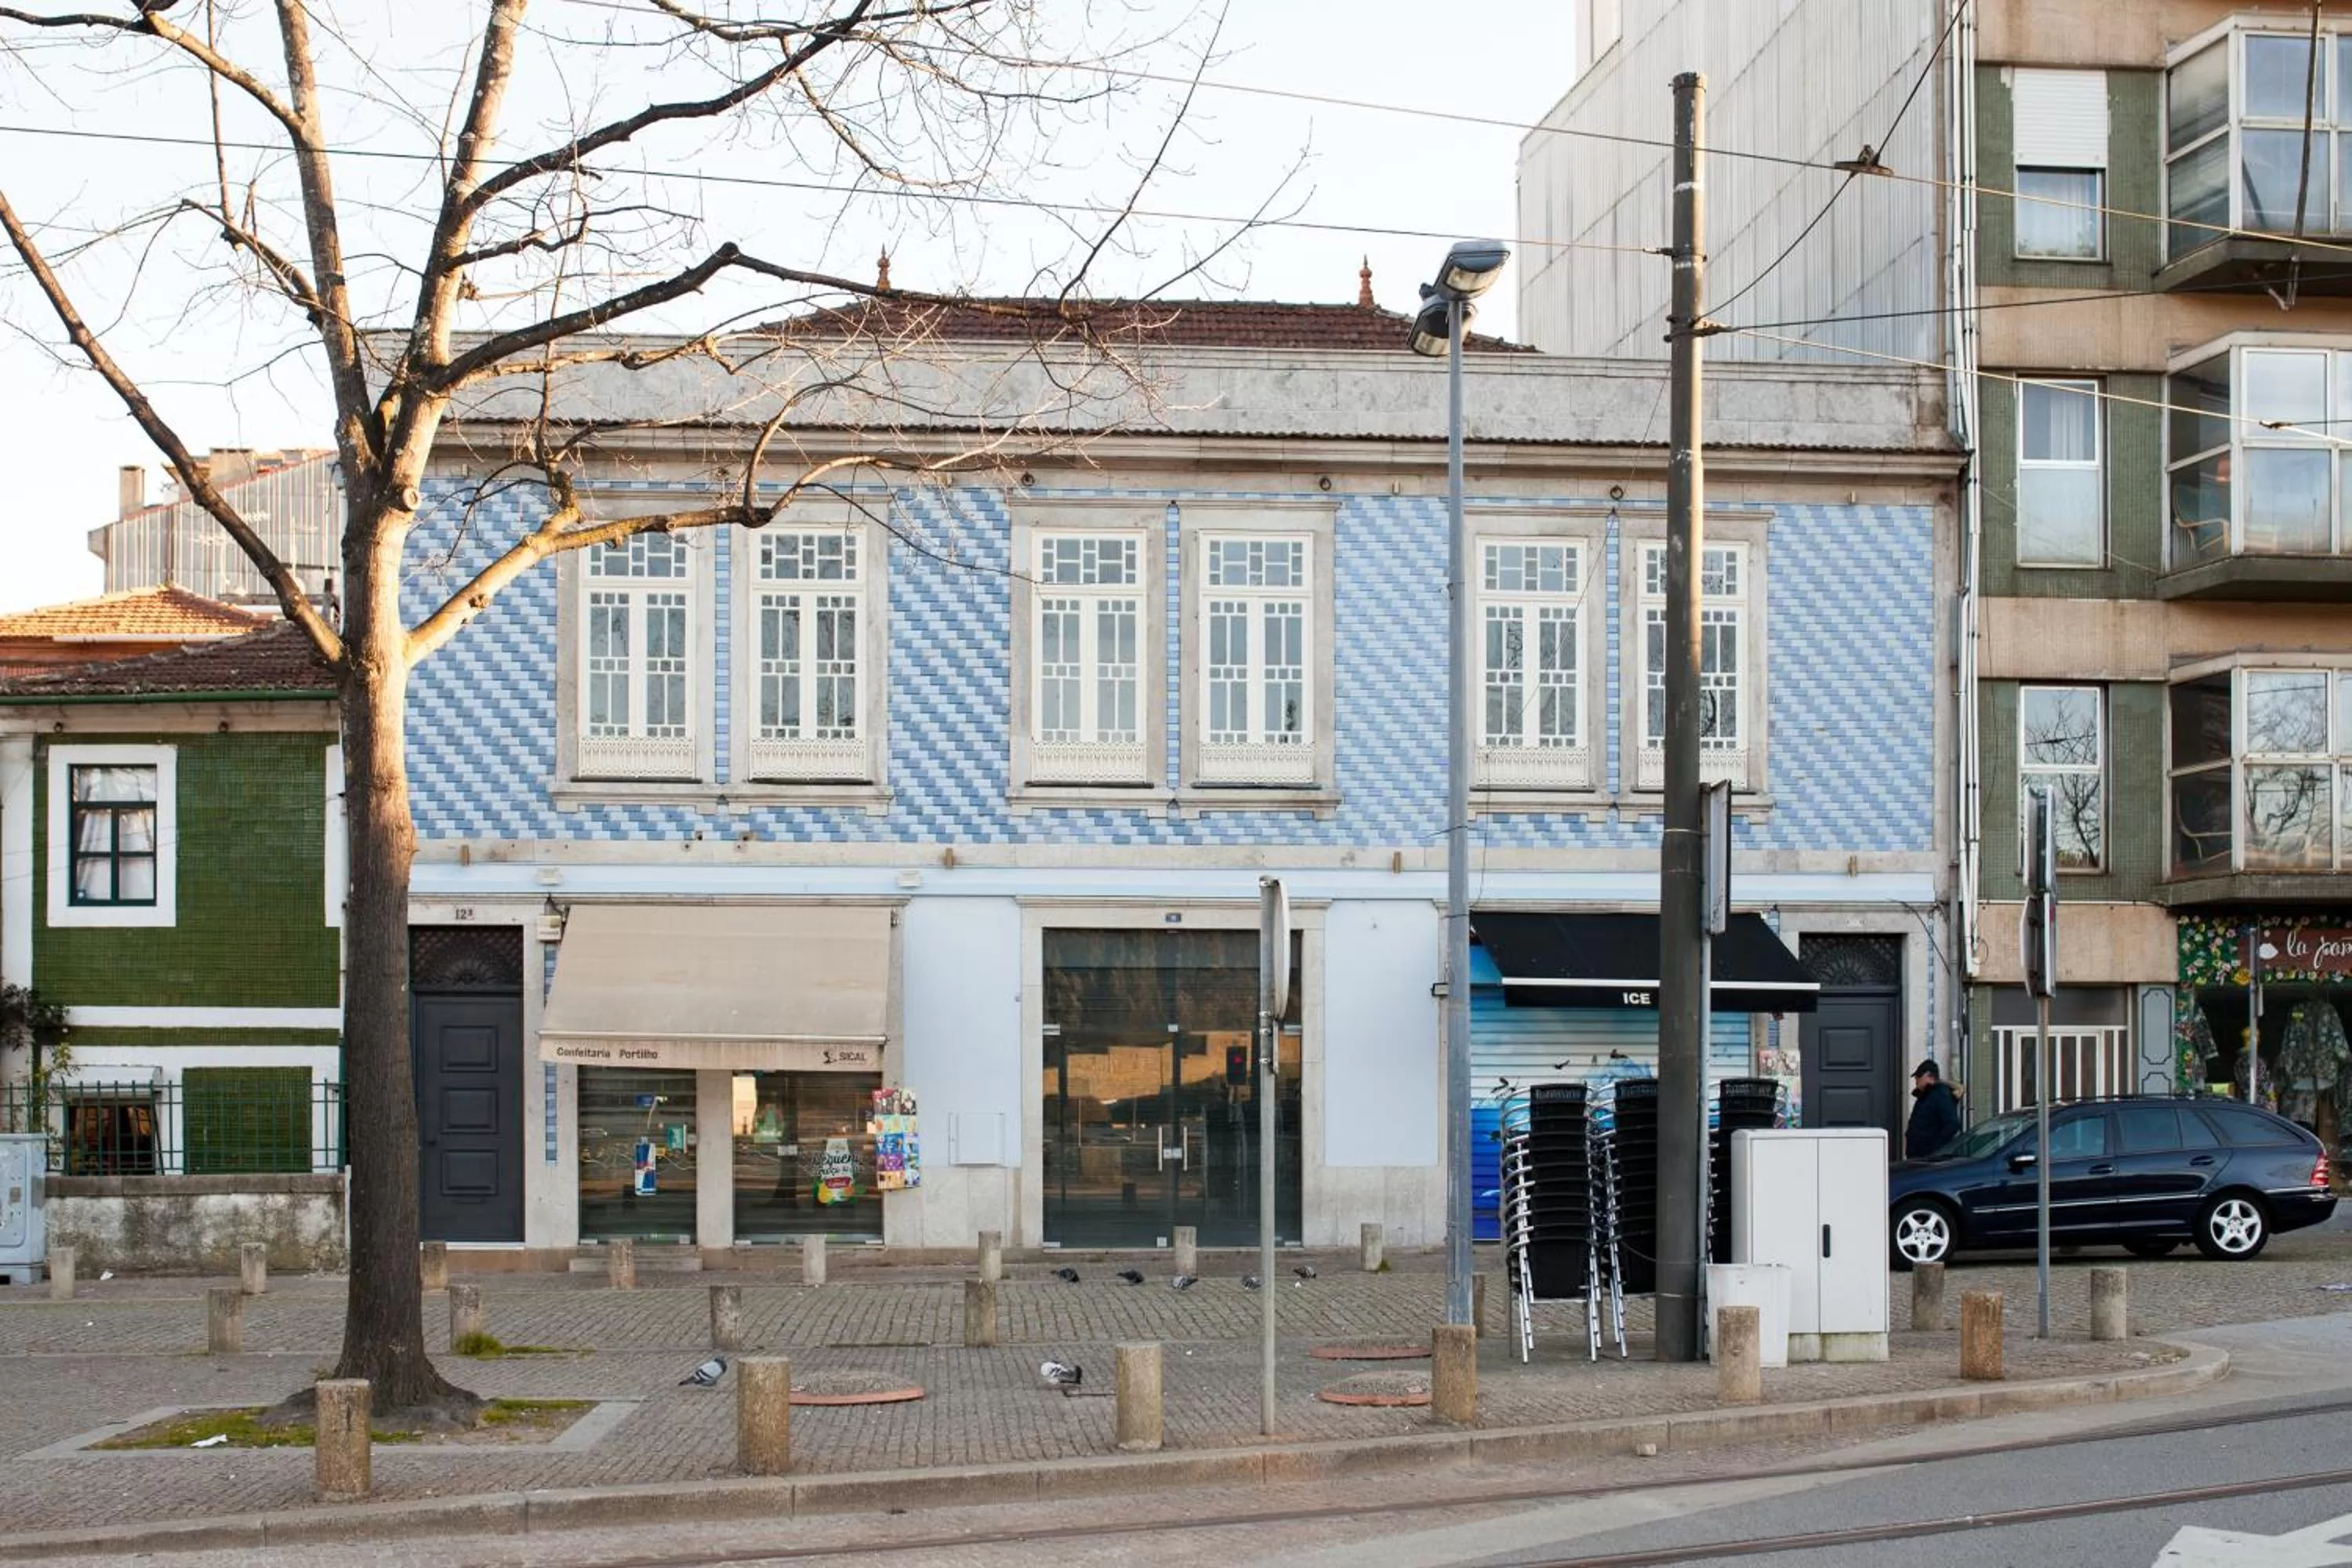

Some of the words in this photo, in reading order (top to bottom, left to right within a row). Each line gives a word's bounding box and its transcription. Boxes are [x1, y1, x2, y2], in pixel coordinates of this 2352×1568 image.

[2287, 929, 2307, 956] la
[1622, 992, 1652, 1004] ICE
[557, 1047, 611, 1058] Confeitaria
[619, 1049, 658, 1059] Portilho
